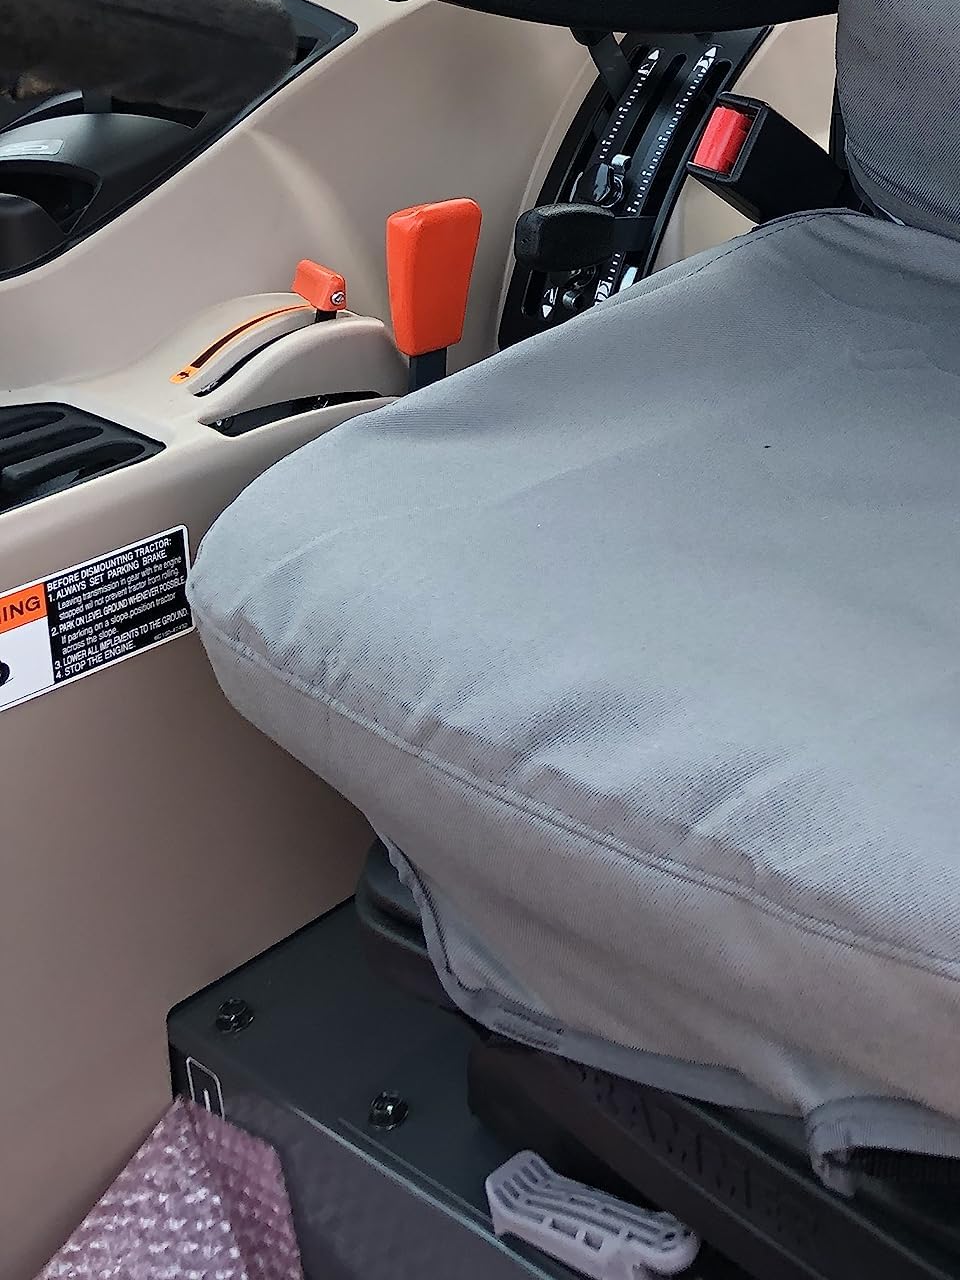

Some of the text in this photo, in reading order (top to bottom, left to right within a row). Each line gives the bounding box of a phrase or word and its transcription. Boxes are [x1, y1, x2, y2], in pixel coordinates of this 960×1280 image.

[47, 571, 79, 592] BEFORE
[80, 551, 133, 579] DISMOUNTING
[55, 579, 86, 599] ALWAYS
[88, 572, 104, 587] SET
[107, 559, 139, 580] PARKING
[57, 593, 82, 612] Leaving
[82, 578, 119, 600] transmission
[126, 571, 140, 585] gear
[140, 565, 152, 578] with
[152, 562, 162, 573] the
[163, 554, 181, 571] engine
[58, 603, 84, 622] stopped
[94, 595, 104, 606] not
[104, 585, 127, 604] prevent
[127, 578, 146, 593] tractor
[147, 573, 160, 585] from
[58, 618, 75, 633] PARK
[84, 607, 103, 623] LEVEL
[103, 597, 127, 616] GROUND
[128, 585, 159, 606] WHENEVER
[67, 623, 93, 644] parking
[155, 590, 176, 606] tractor
[62, 648, 87, 666] LOWER
[87, 643, 99, 656] ALL
[99, 627, 139, 651] IMPLEMENTS
[148, 617, 161, 631] THE
[62, 639, 85, 655] across
[85, 633, 97, 645] the
[64, 659, 86, 676] STOP
[86, 652, 103, 667] THE
[104, 638, 136, 660] ENGINE.
